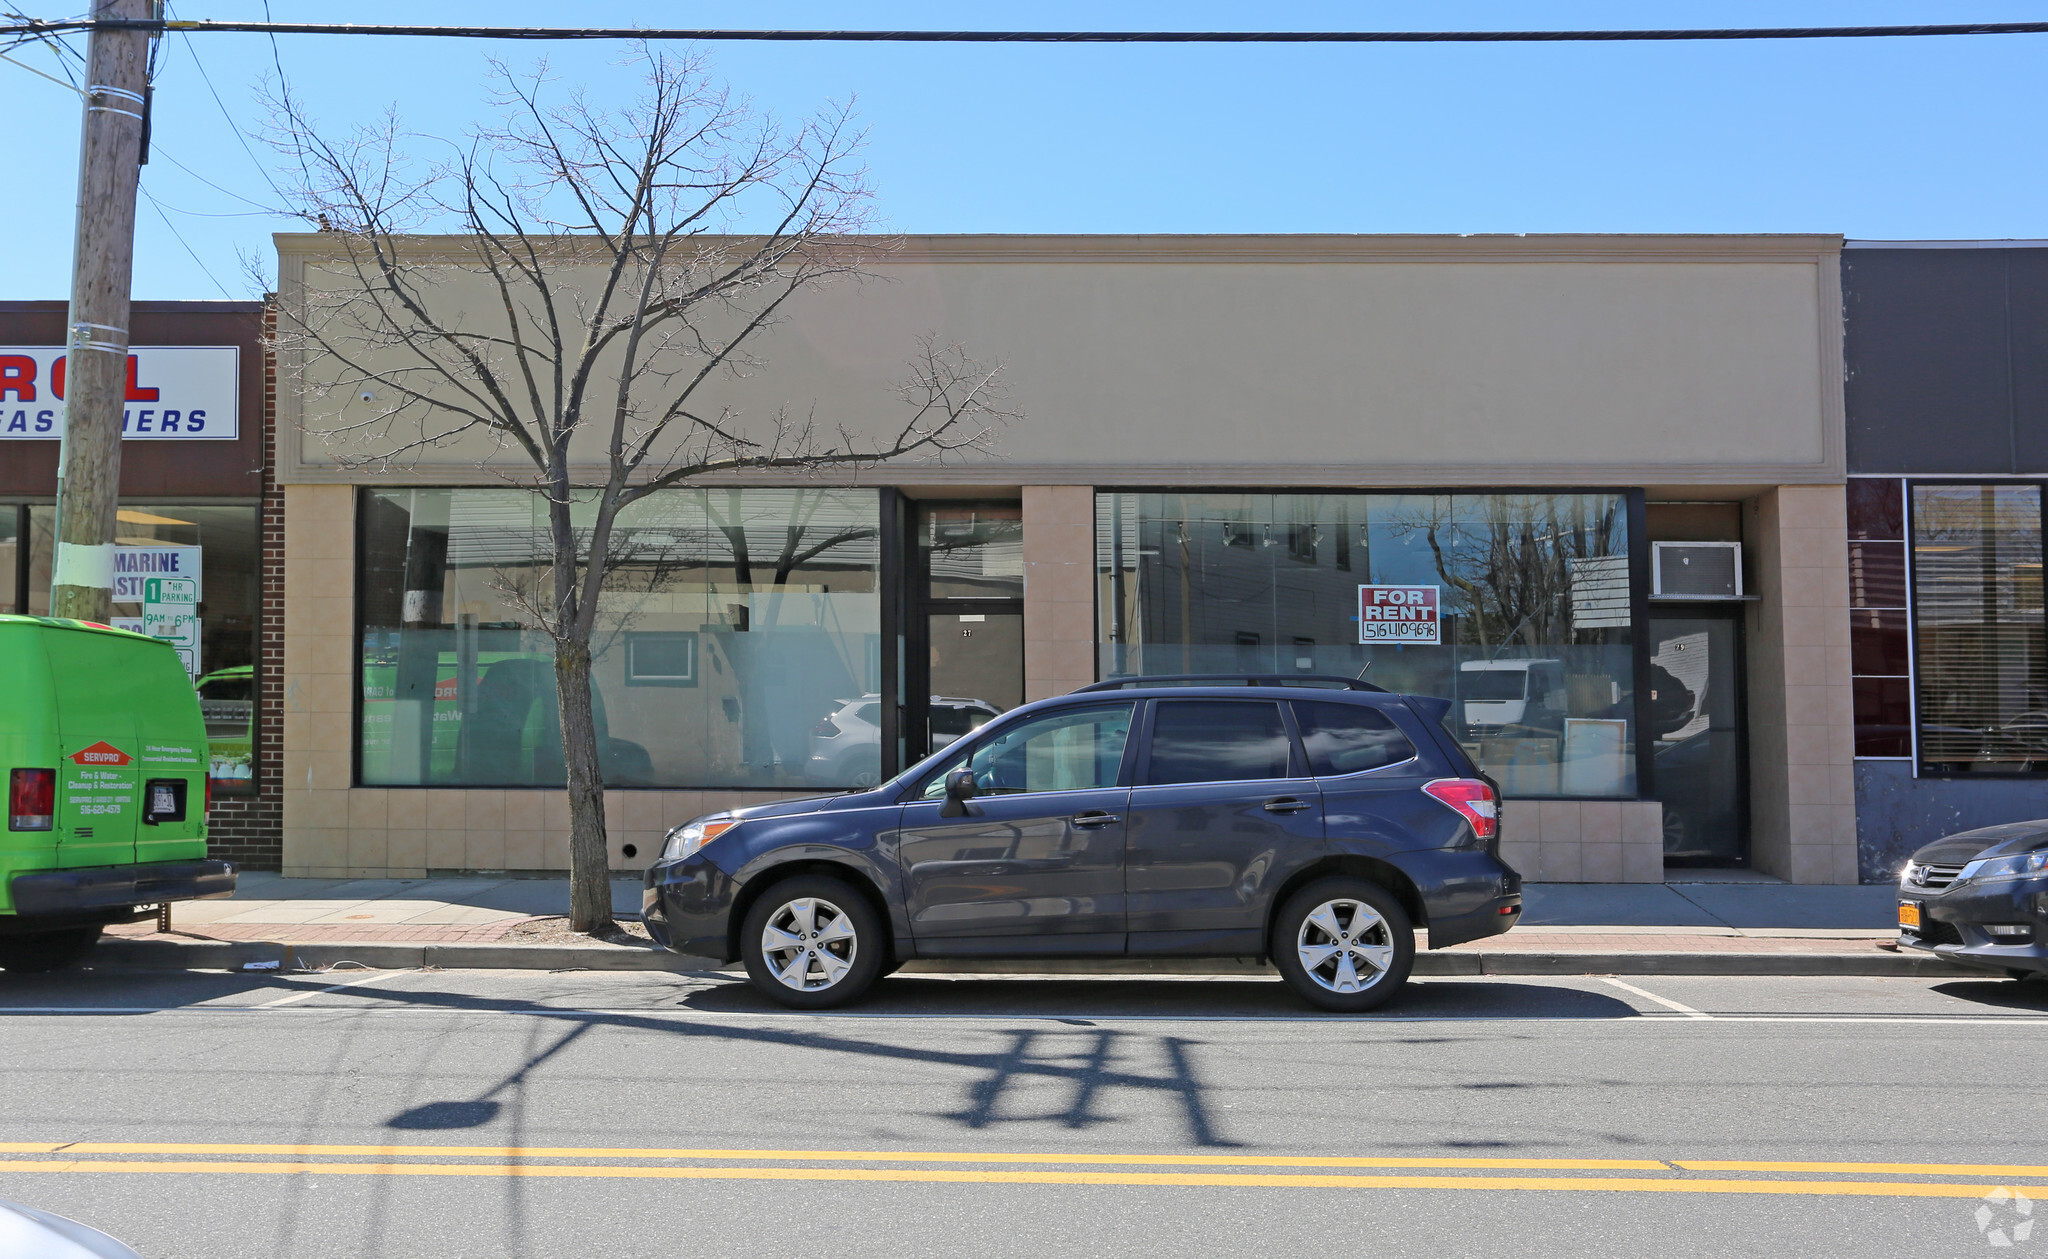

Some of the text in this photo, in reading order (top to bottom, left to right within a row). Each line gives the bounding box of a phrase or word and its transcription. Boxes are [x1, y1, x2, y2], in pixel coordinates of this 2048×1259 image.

[114, 553, 179, 572] MARINE
[150, 583, 156, 600] 1
[172, 582, 183, 592] HR
[162, 592, 193, 603] PARKING
[1373, 590, 1425, 605] FOR
[1365, 605, 1433, 620] RENT
[146, 613, 165, 626] 9AM
[174, 614, 194, 628] 6PM
[84, 752, 119, 763] SERVPRO
[80, 771, 93, 780] Fire
[68, 780, 92, 791] Cleanup
